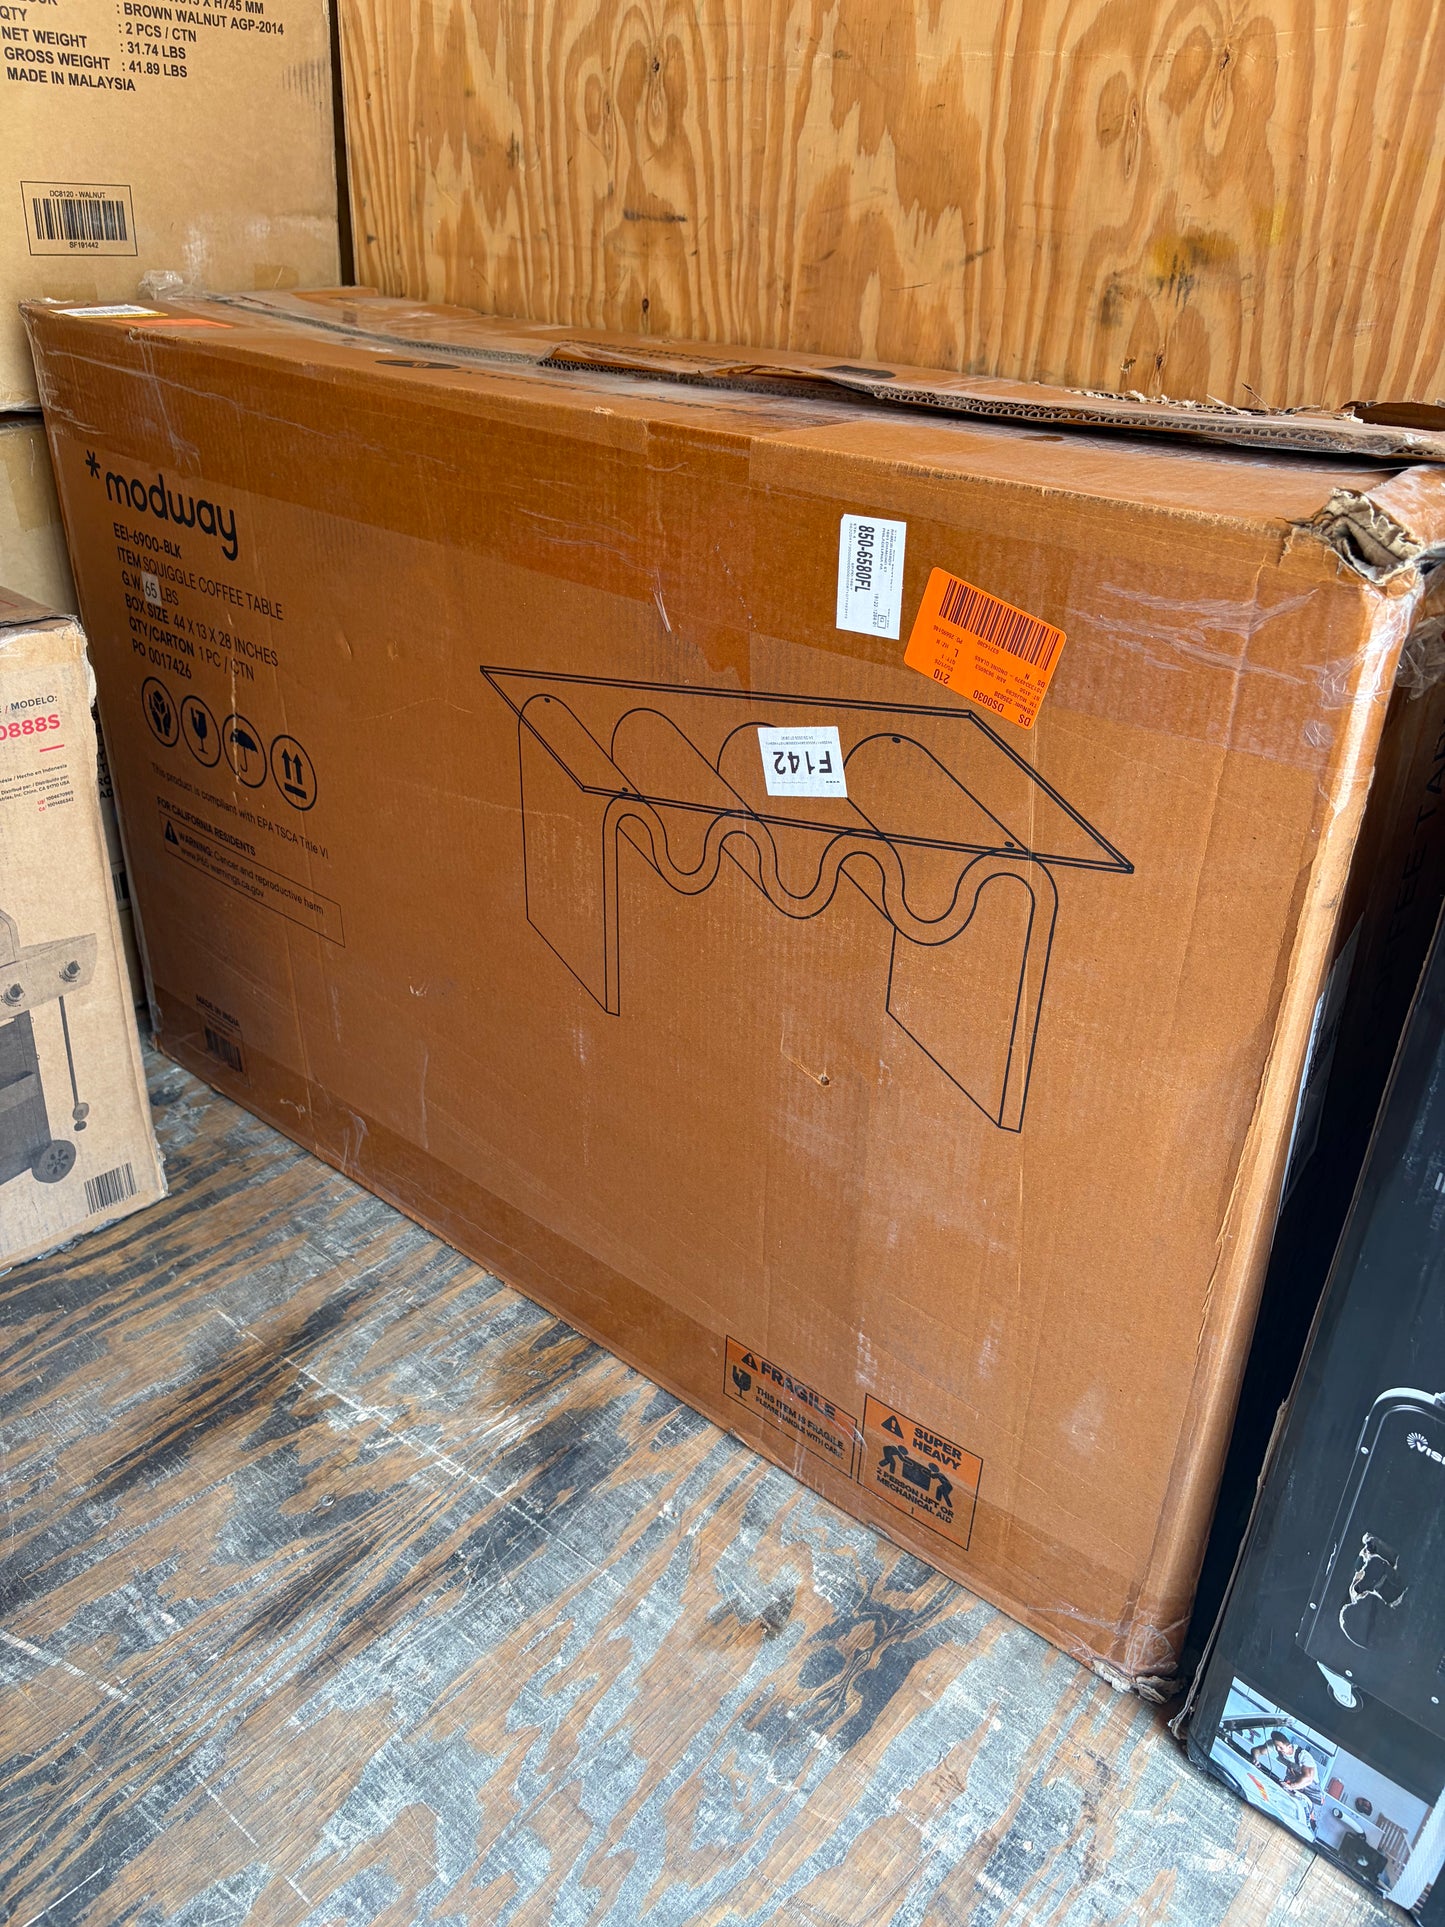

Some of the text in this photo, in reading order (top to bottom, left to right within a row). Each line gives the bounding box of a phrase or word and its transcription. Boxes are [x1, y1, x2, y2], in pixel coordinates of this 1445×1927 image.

[0, 6, 27, 21] QTY
[126, 22, 132, 35] 2
[136, 24, 162, 38] PCS
[172, 28, 196, 42] CTN
[124, 2, 172, 20] BROWN
[175, 9, 228, 28] WALNUT
[231, 18, 284, 36] AGP-2014
[245, 1, 264, 14] MM
[1, 26, 29, 42] NET
[32, 30, 87, 48] WEIGHT
[128, 42, 159, 56] 31.74
[162, 45, 186, 59] LBS
[4, 46, 54, 64] GROSS
[58, 52, 110, 70] WEIGHT
[129, 60, 160, 75] 41.89
[164, 64, 188, 78] LBS
[6, 66, 136, 91] MADE IN MALAYSIA
[106, 472, 238, 561] modway
[113, 522, 182, 559] EEI-6900-BLK
[855, 525, 875, 592] 850-6580FL
[118, 546, 284, 620] ITEM SQUIGGLE COFFEE TABLE
[145, 580, 158, 599] 65
[160, 588, 179, 606] LBS
[125, 593, 279, 667] BOX SIZE 44 X 13 X 28 INCHES
[132, 638, 192, 680] PO 0017426
[206, 649, 220, 668] PC
[230, 658, 254, 680] CTN
[934, 669, 950, 684] 210
[11, 695, 58, 710] MODELO:
[972, 690, 1004, 712] DS0030
[1018, 714, 1031, 726] DS
[42, 764, 67, 773] Indonesia
[773, 751, 832, 774] F142
[157, 796, 256, 856] FOR CALIFORNIA RESIDENTS
[239, 809, 255, 824] with
[257, 816, 274, 832] EPA
[275, 824, 298, 845] TSCA
[300, 836, 318, 854] Title
[319, 845, 329, 859] VI
[255, 874, 302, 904] reproductive
[304, 896, 324, 915] harm
[756, 1386, 775, 1403] THIS
[776, 1400, 796, 1418] ITEM
[798, 1414, 806, 1425] IS
[761, 1361, 836, 1421] FRAGILE
[756, 1396, 779, 1416] PLEASE
[806, 1430, 824, 1446] WITH
[912, 1438, 961, 1471] HEAVY
[914, 1427, 962, 1461] SUPER
[1416, 1441, 1445, 1465] VIS
[876, 1475, 952, 1524] MECHANICAL AID
[877, 1466, 954, 1519] 2 PERSON LIFT OR
